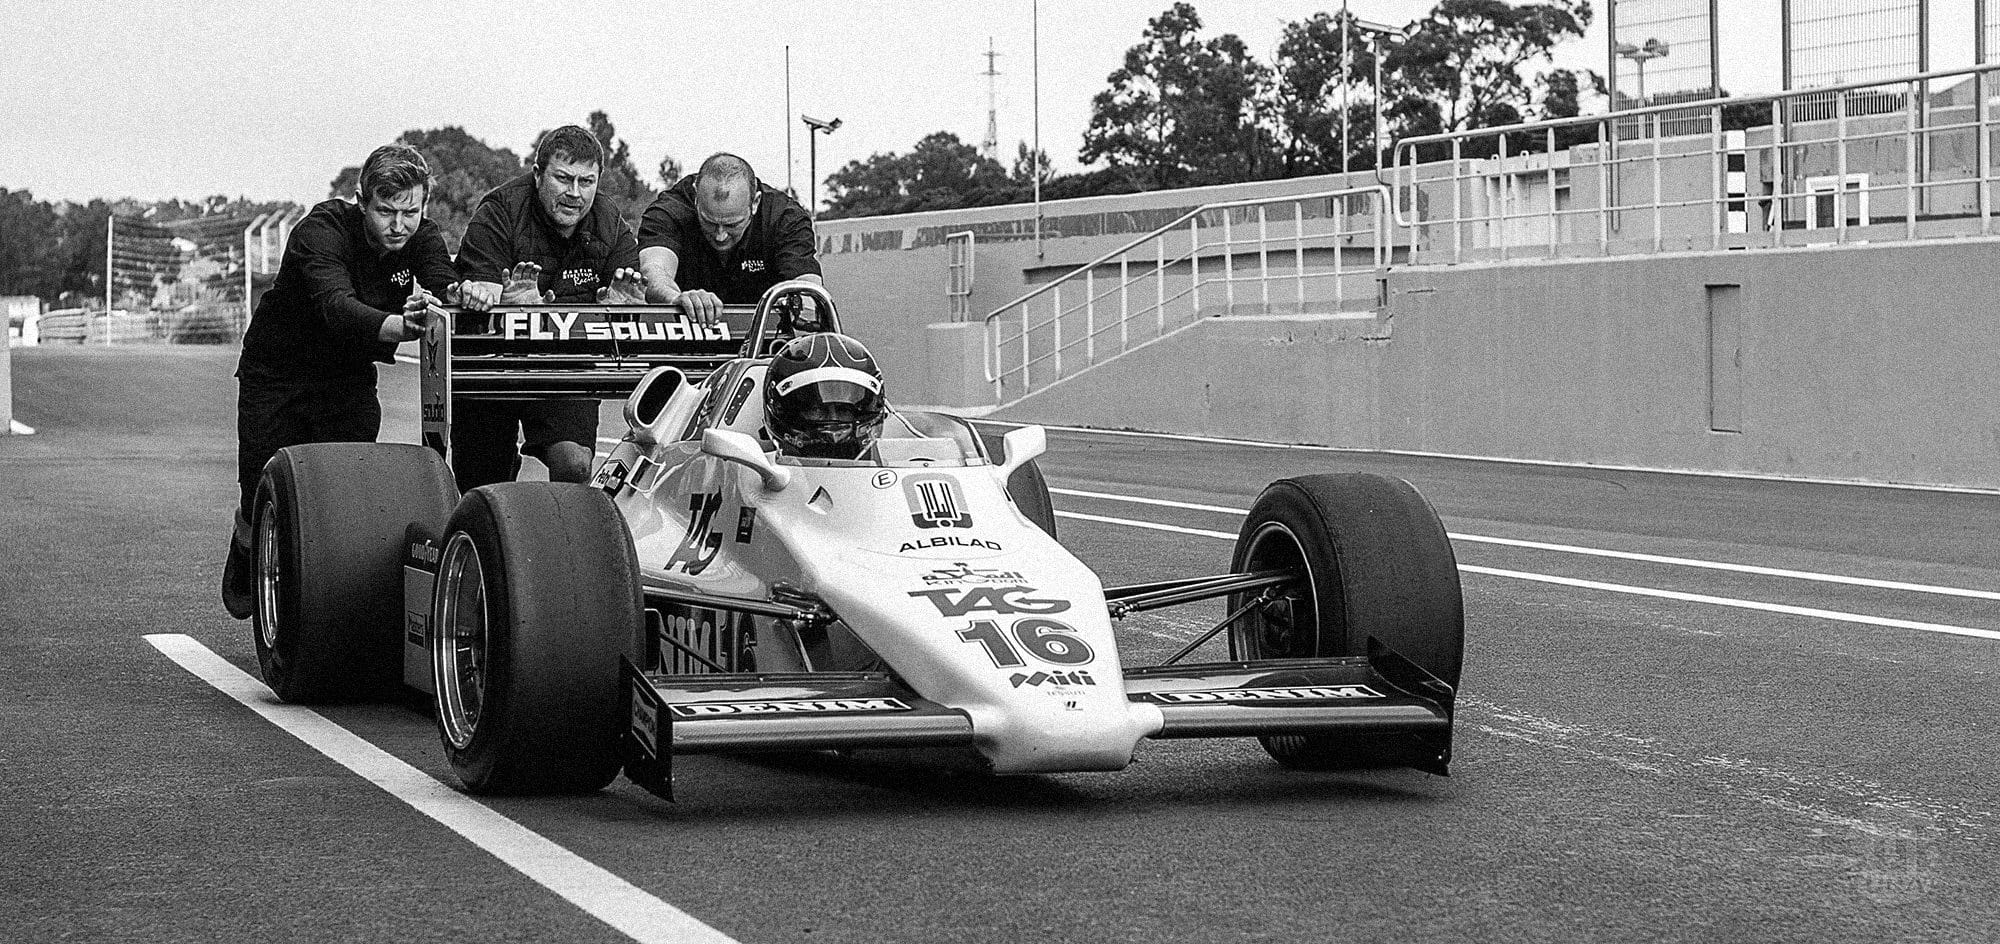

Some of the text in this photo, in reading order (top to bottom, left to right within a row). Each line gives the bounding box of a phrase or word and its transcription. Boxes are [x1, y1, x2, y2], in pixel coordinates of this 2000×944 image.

[504, 312, 731, 341] FLY saudia
[878, 472, 891, 486] E
[663, 485, 724, 576] TAG
[899, 536, 1002, 553] ALBILAD
[907, 584, 1072, 617] TAG
[955, 616, 1096, 669] 16
[1170, 688, 1375, 702] DENIM
[686, 700, 905, 715] DENIM
